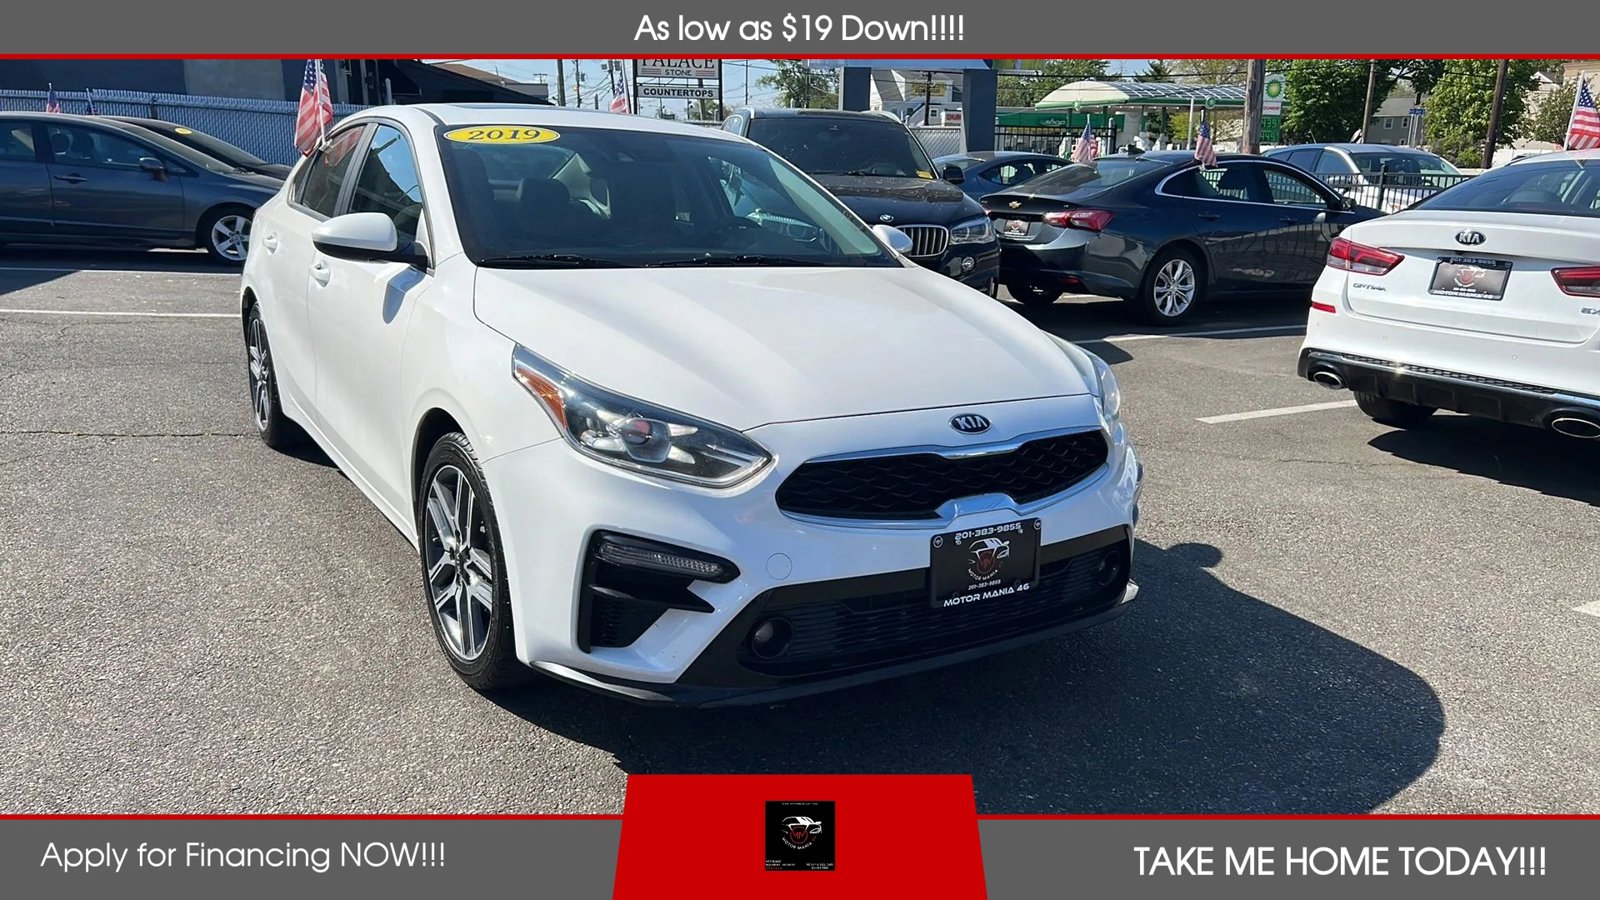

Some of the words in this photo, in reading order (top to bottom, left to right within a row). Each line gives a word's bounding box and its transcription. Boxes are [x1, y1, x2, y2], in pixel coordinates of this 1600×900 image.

[643, 88, 714, 97] COUNTERTOPS
[468, 129, 541, 140] 2019
[1458, 232, 1480, 243] KIA
[954, 415, 988, 430] KIA
[954, 522, 1022, 541] 201-383-9855
[943, 593, 981, 607] MOTOR
[982, 586, 1015, 600] MANIA
[1016, 583, 1030, 592] 46
